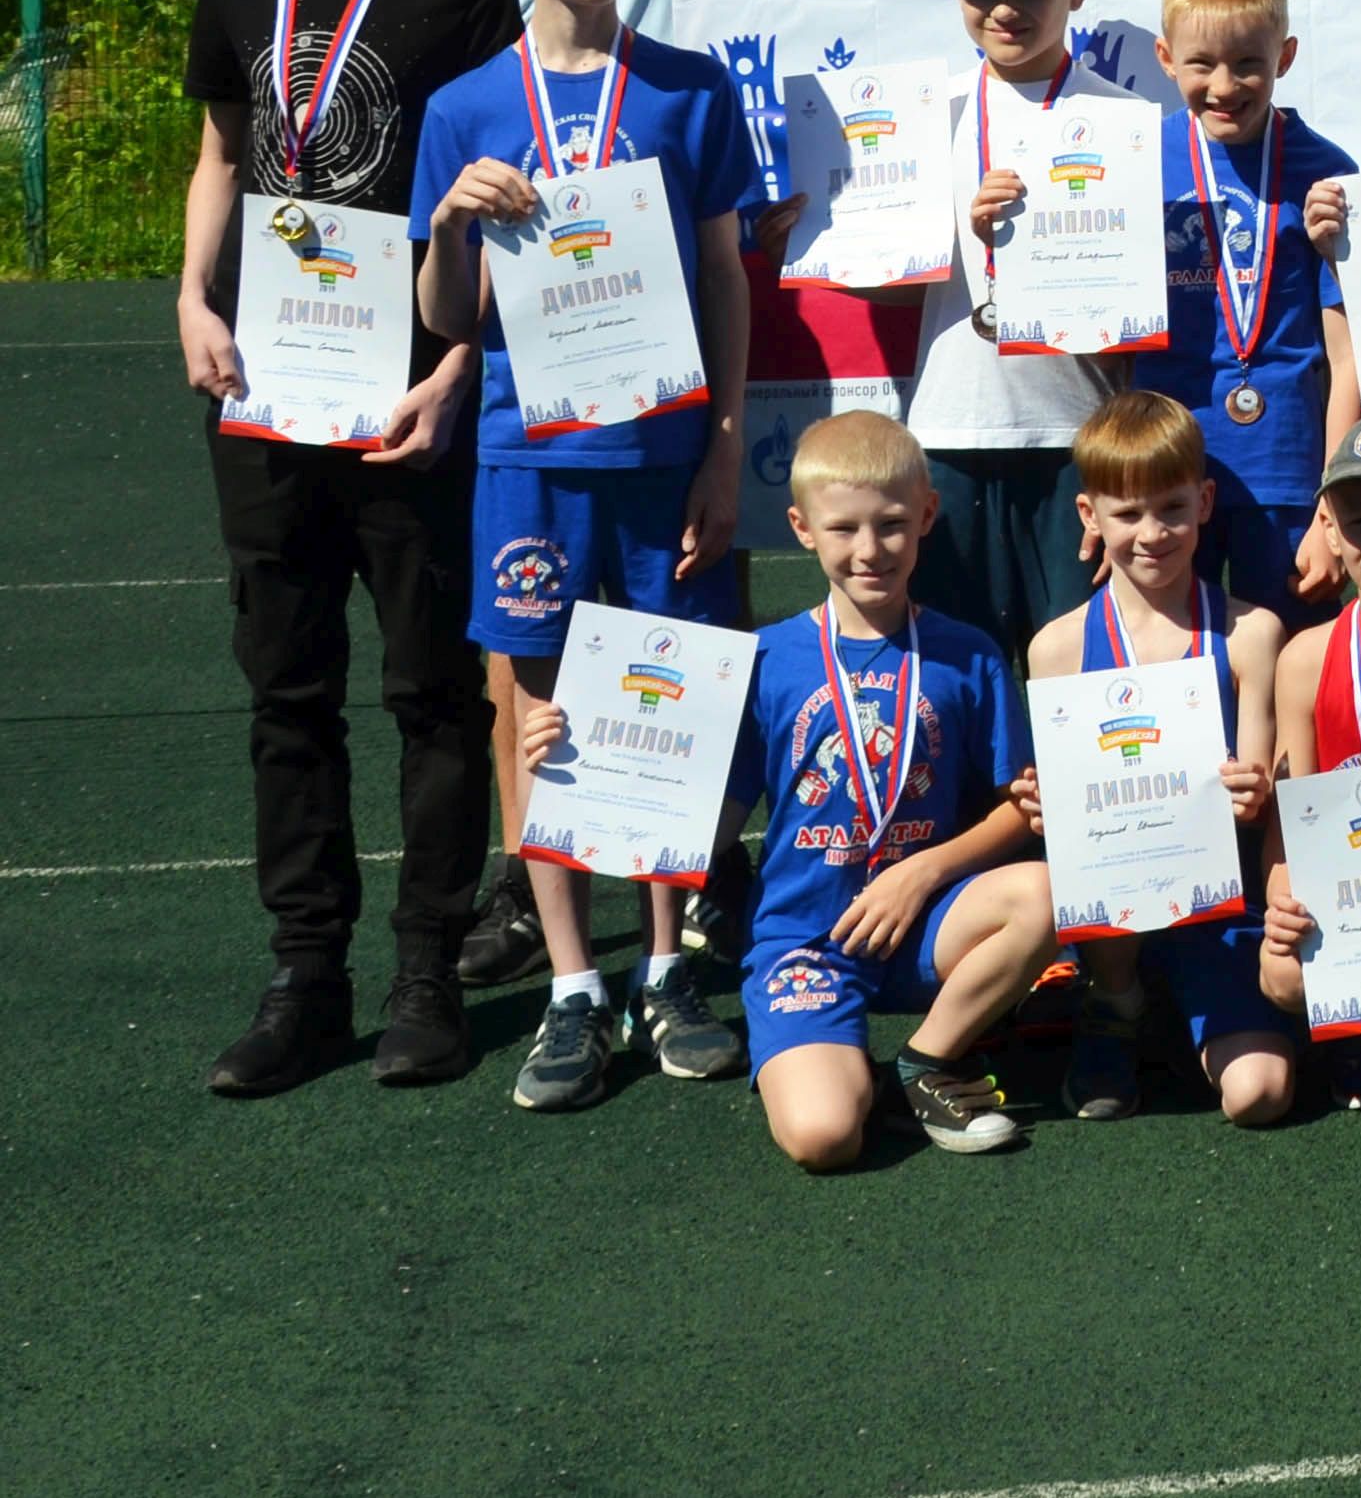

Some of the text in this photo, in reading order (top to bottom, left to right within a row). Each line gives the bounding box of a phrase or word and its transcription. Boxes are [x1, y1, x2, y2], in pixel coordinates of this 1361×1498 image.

[829, 159, 917, 198] ДИПЛОМ
[1032, 208, 1125, 238] ДИПЛОМ
[541, 270, 644, 316] ДИПЛОМ
[277, 297, 375, 330] ДИПЛОМ
[823, 384, 878, 400] спонсор
[587, 717, 695, 758] ДИПЛОМ
[1123, 757, 1142, 767] 2019
[1085, 770, 1189, 813] ДИПЛОМ
